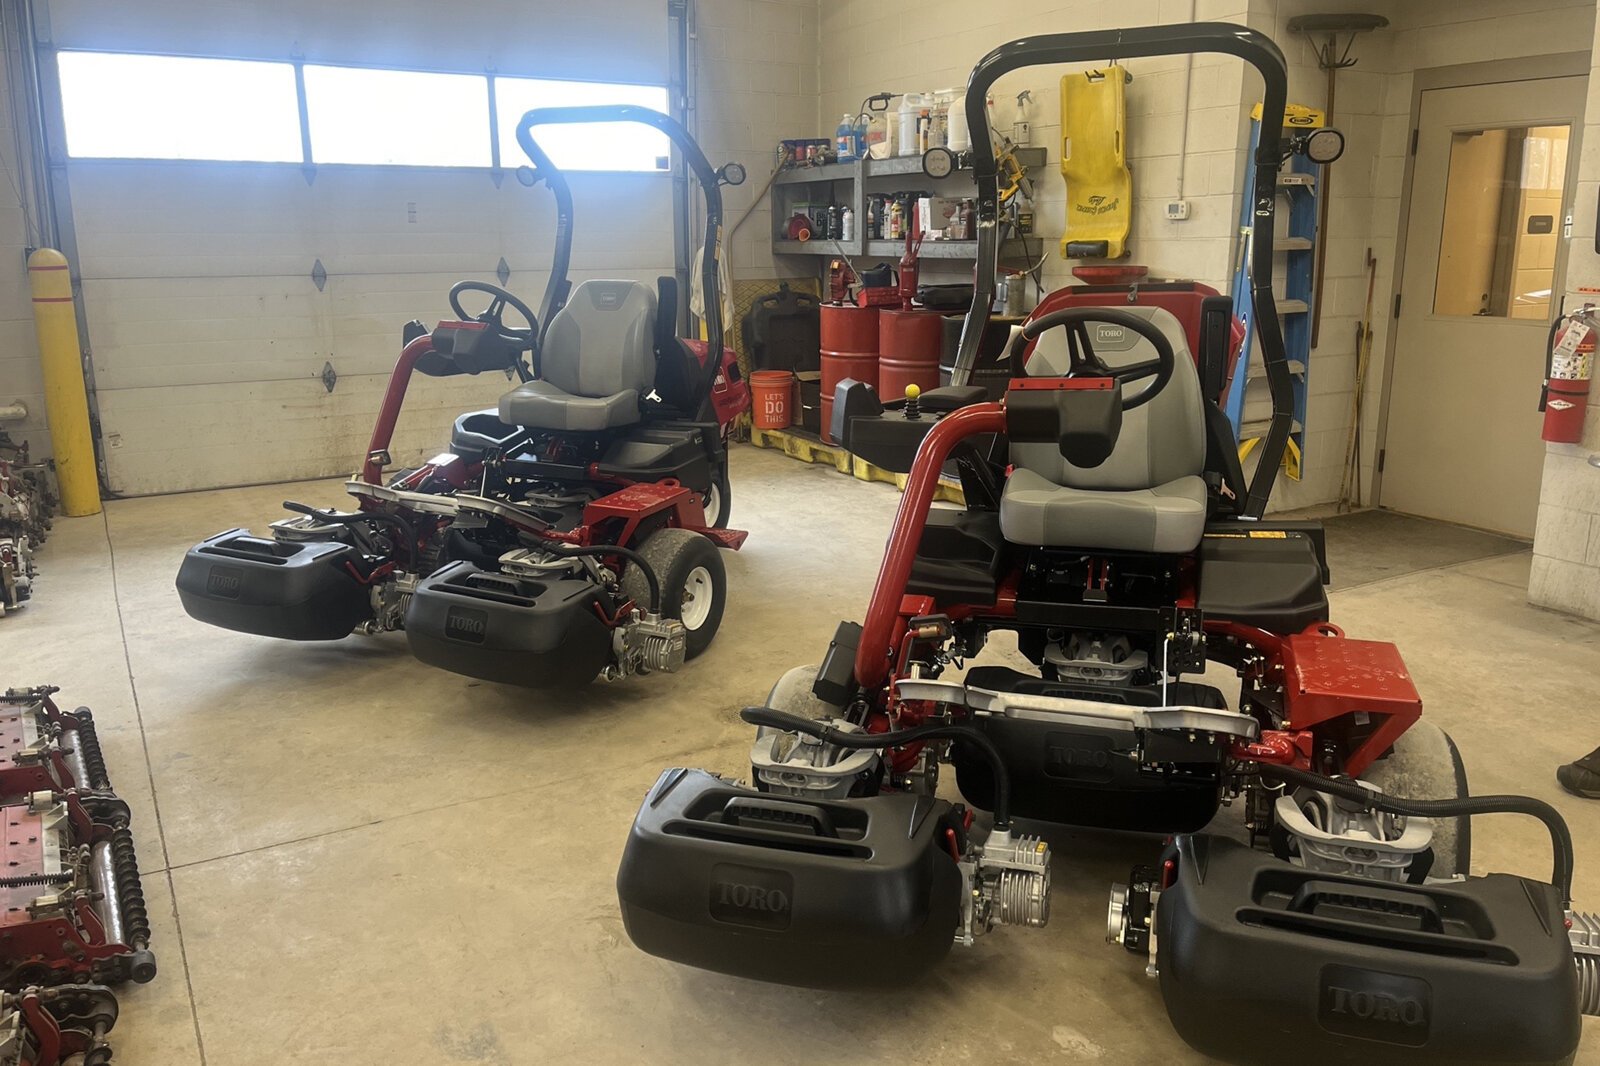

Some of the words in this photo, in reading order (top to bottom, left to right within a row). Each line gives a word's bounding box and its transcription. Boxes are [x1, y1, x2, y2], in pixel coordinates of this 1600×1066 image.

[765, 401, 784, 414] DO
[450, 615, 484, 634] TORO
[717, 881, 788, 912] TORO
[1328, 985, 1424, 1025] TORO
